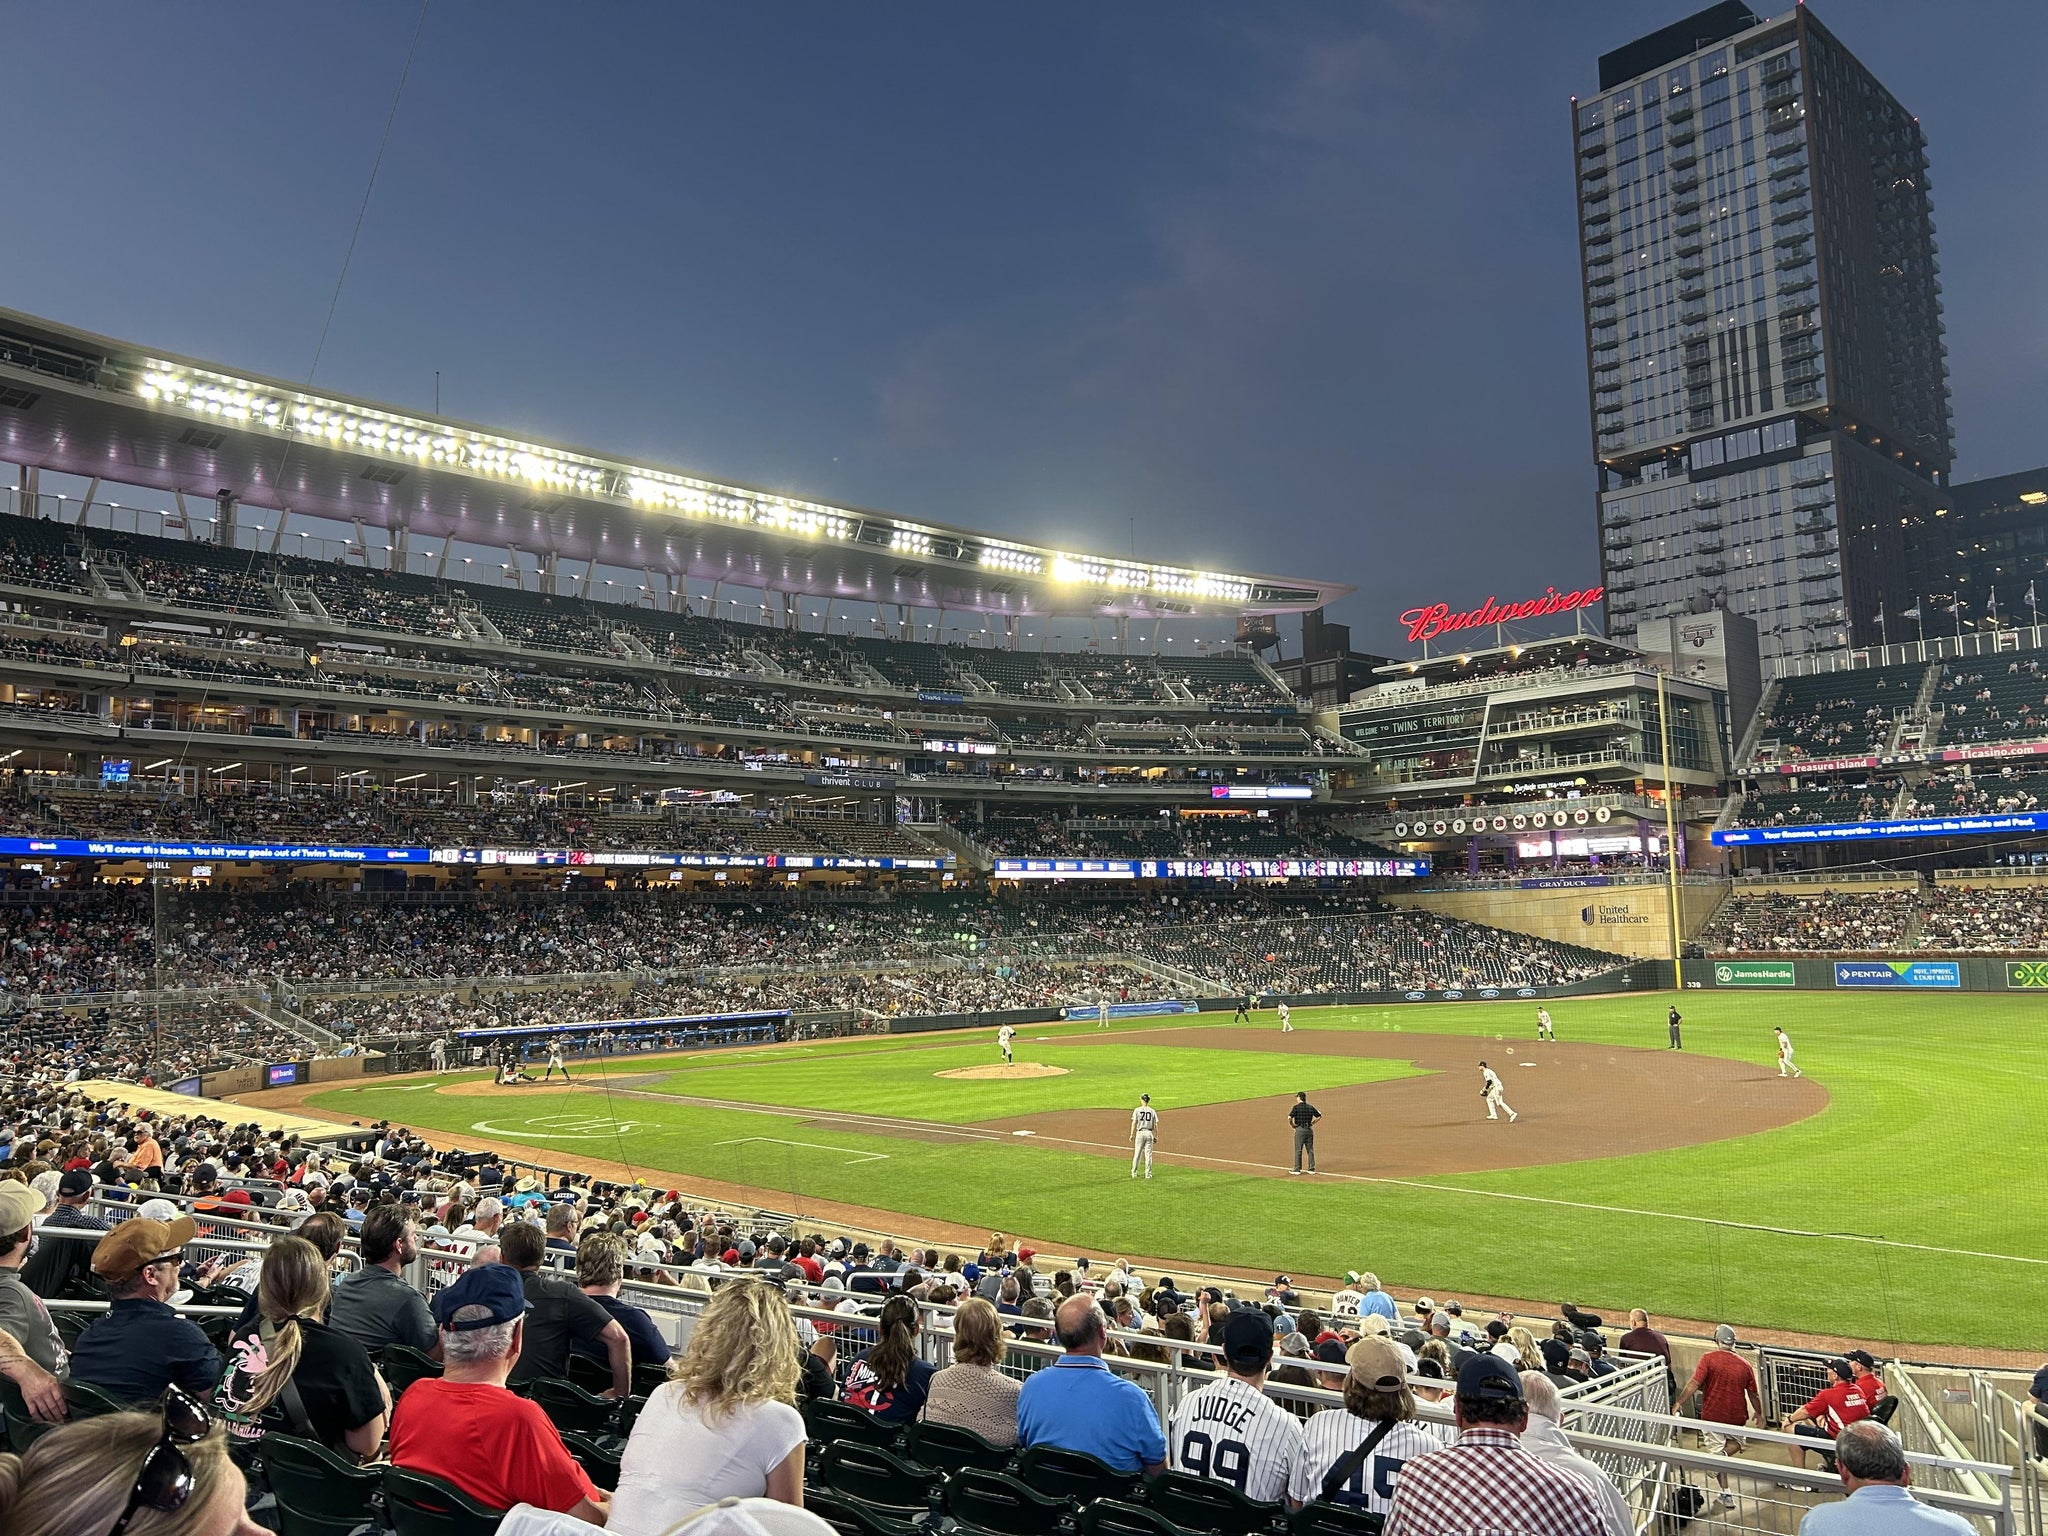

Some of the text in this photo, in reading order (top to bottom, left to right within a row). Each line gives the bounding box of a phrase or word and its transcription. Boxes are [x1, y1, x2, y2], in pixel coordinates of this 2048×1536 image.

[1399, 586, 1604, 642] Budweiser
[1355, 727, 1378, 737] WELCOME
[1392, 720, 1419, 733] TWINS
[1423, 714, 1465, 728] TERRITORY
[1381, 757, 1419, 771] WE ARE ALL
[1790, 759, 1867, 773] Treasure Island
[821, 776, 881, 788] thrivent CLUB
[1601, 811, 1606, 819] 3
[1516, 818, 1524, 826] 34
[1536, 816, 1543, 824] 14
[1416, 825, 1424, 833] 42
[1436, 823, 1444, 831] 36
[1456, 822, 1461, 830] 7
[1476, 821, 1483, 829] 10
[1763, 831, 1781, 840] Your
[1818, 829, 1832, 837] our
[1886, 824, 1919, 834] perfect
[1920, 823, 1942, 831] team
[1943, 821, 1960, 830] like
[1993, 818, 2011, 827] and
[89, 843, 366, 860] We'll cover the bases. You hit your goals out of Twins Territory.
[767, 856, 777, 867] 21
[1599, 904, 1629, 914] United
[1600, 915, 1649, 924] Healthcare
[1734, 970, 1791, 978] JamesHardie
[1851, 970, 1892, 978] PENTAIR
[279, 1069, 293, 1077] bank
[1140, 1112, 1152, 1121] 70
[1336, 1295, 1360, 1306] HUNTER
[1192, 1396, 1256, 1434] JUDGE
[1180, 1430, 1250, 1492] 99
